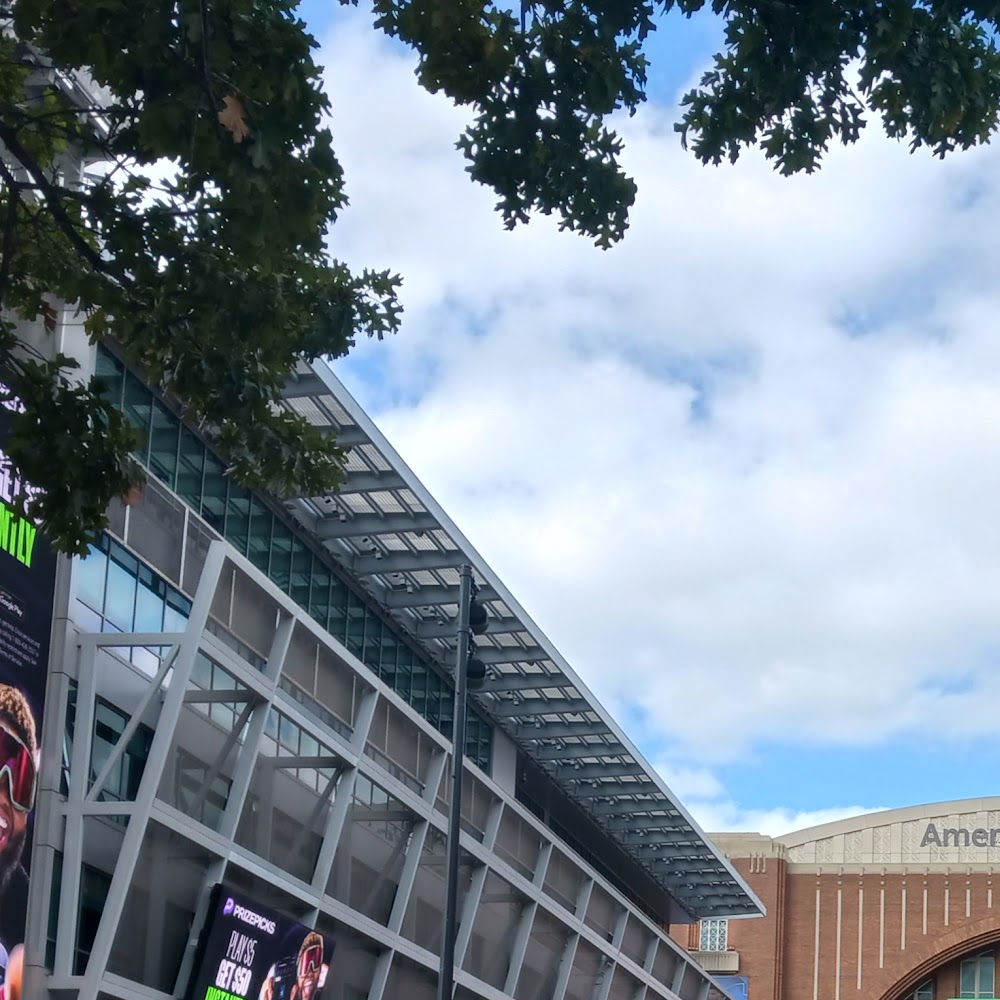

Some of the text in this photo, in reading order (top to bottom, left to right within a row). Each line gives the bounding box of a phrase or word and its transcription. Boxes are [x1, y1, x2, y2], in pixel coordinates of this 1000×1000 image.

[232, 905, 277, 934] PRIZEPICKS
[226, 930, 258, 966] PLAY $5
[215, 959, 252, 996] GET $50
